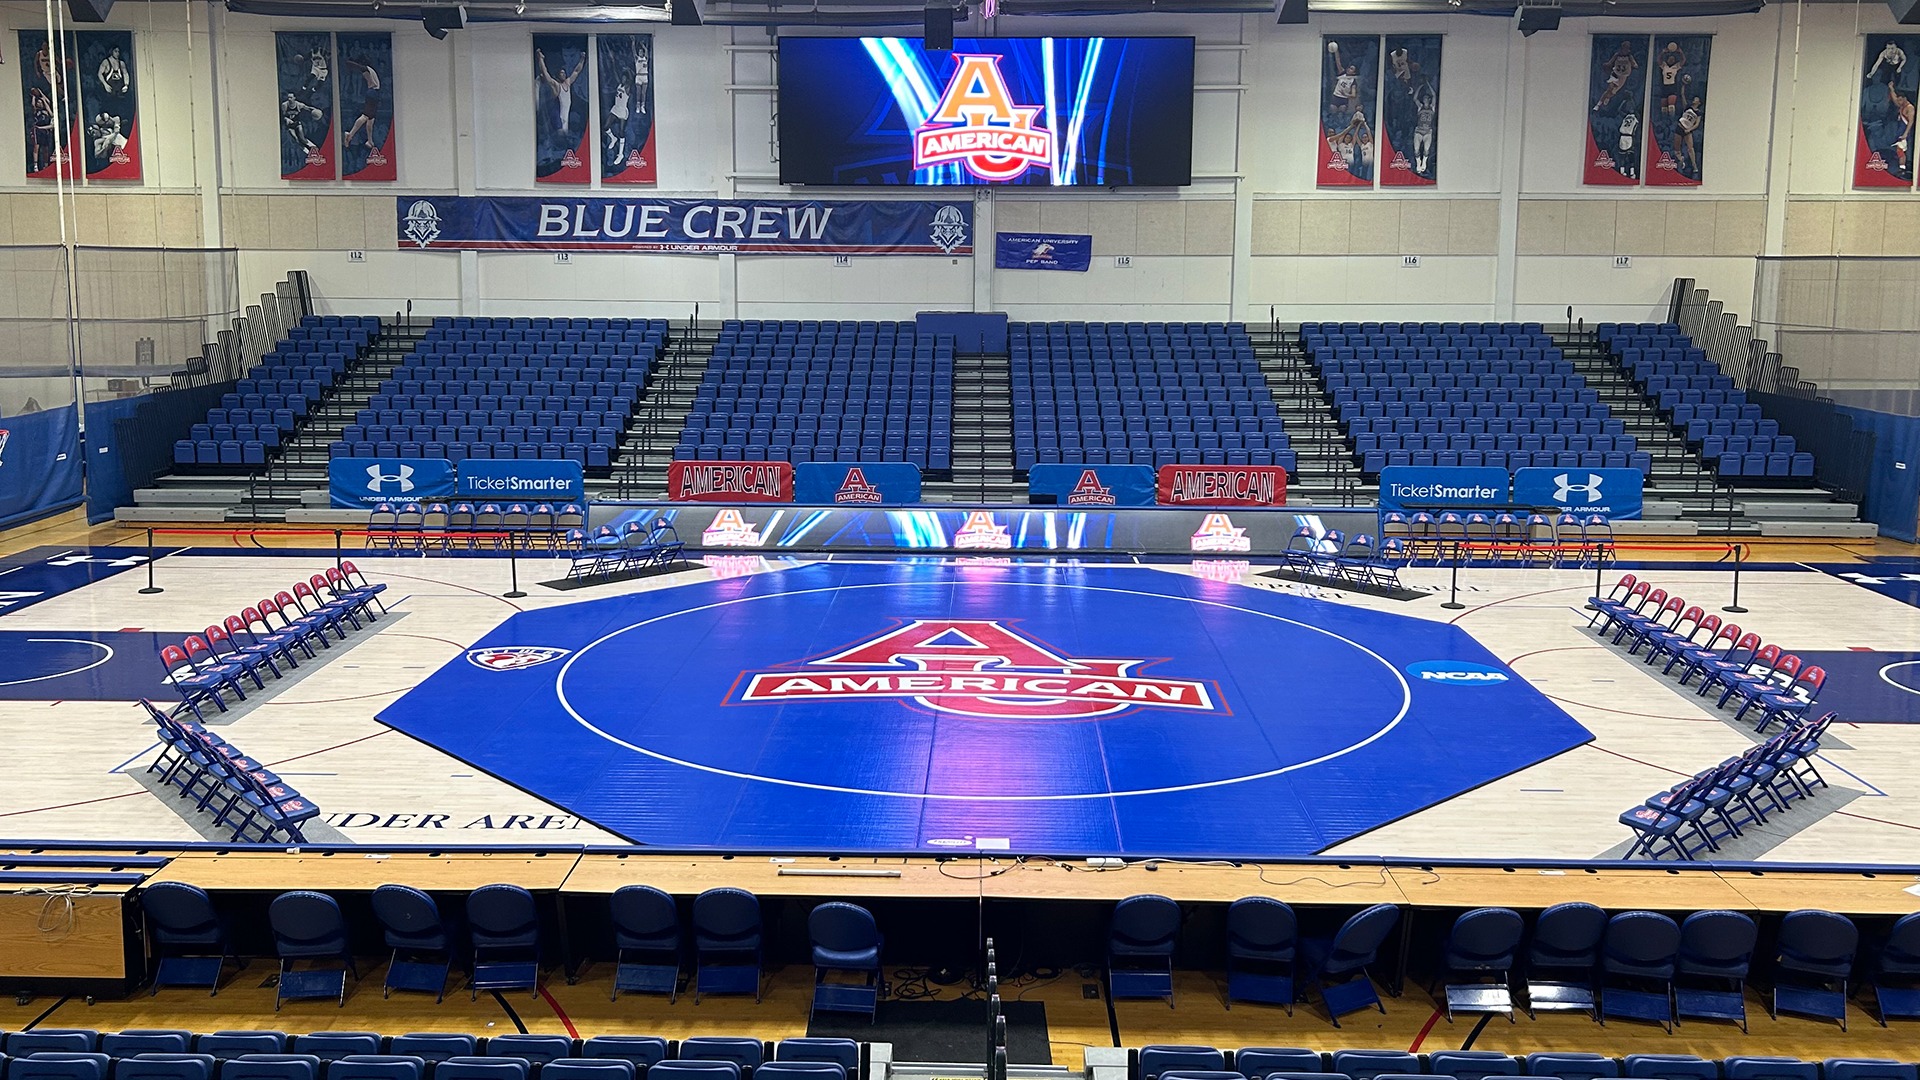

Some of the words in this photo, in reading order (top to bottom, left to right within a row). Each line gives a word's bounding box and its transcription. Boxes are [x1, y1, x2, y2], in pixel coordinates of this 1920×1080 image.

[924, 132, 1044, 155] AMERICAN
[537, 204, 671, 237] BLUE
[682, 205, 833, 240] CREW
[1404, 256, 1417, 264] 116
[467, 475, 572, 490] TicketSmarter
[680, 465, 781, 497] AMERICAN
[1170, 470, 1275, 503] AMERICAN
[837, 493, 880, 501] AMERICAN
[1070, 495, 1113, 503] AMERICAN
[1390, 483, 1498, 499] TicketSmarter
[1421, 671, 1509, 680] NCAA
[770, 675, 1188, 700] AMERICAN
[460, 814, 584, 830] ARE
